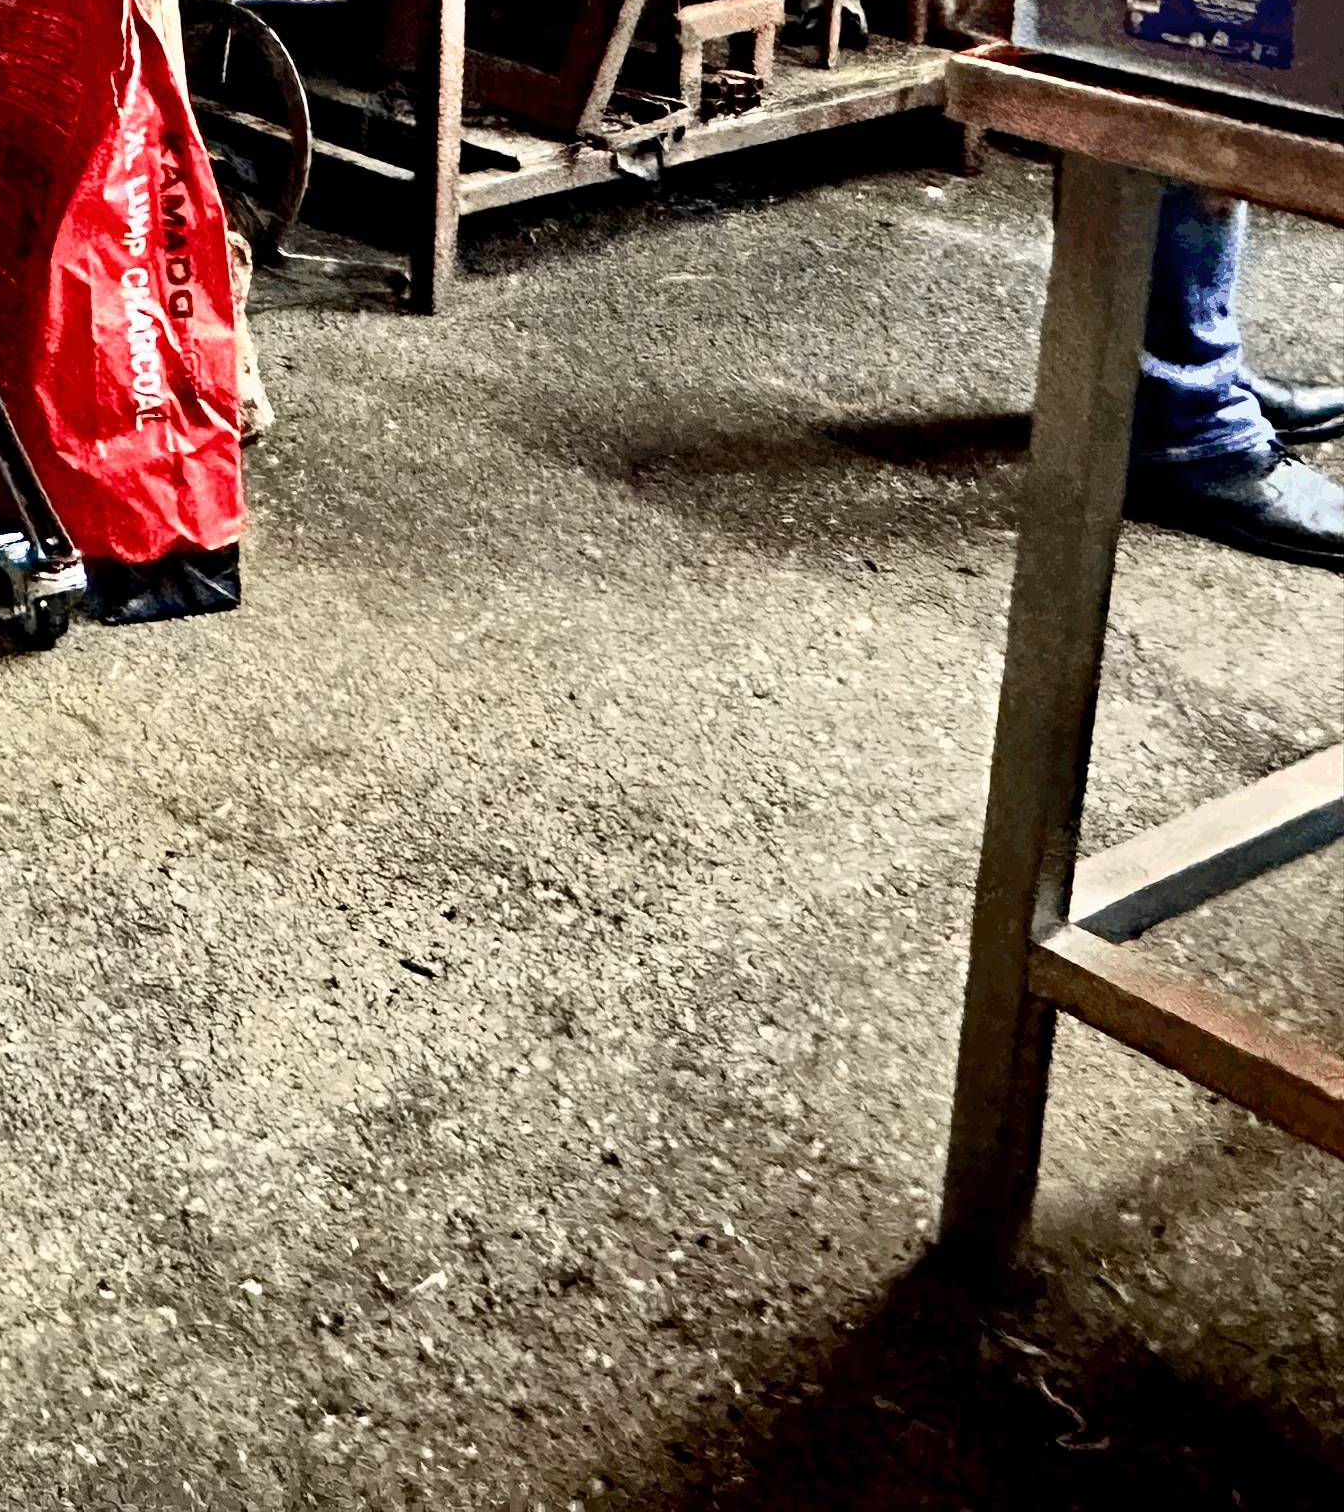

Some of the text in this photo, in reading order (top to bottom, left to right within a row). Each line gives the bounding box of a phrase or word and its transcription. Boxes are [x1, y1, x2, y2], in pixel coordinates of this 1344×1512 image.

[120, 128, 170, 433] XL LUMP CHARCOAL
[159, 130, 194, 320] KAMADO
